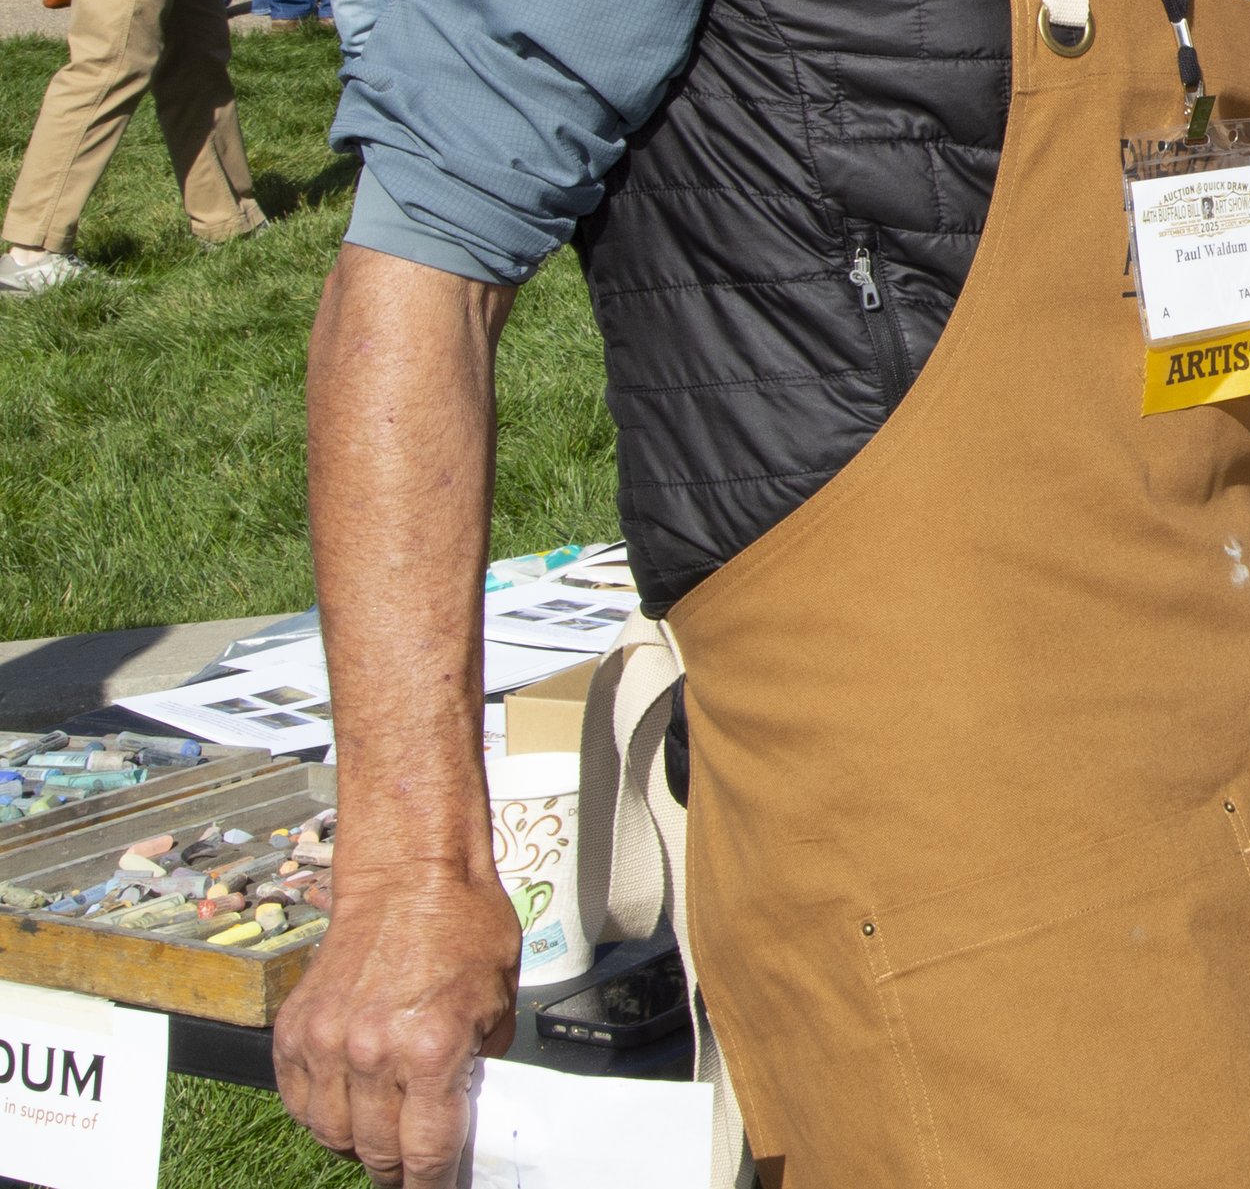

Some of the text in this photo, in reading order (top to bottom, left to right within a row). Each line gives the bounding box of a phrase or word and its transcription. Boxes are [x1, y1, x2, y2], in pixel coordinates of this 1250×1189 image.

[1163, 186, 1195, 203] AUCTION
[1203, 182, 1225, 193] QUICK
[1227, 181, 1249, 192] DRAW
[1142, 209, 1157, 224] 44TH
[1158, 205, 1186, 222] BUFFALO
[1187, 202, 1201, 219] BILL
[1215, 199, 1228, 213] ART
[1228, 195, 1247, 212] SHOW
[1200, 221, 1220, 233] 2025
[1176, 241, 1248, 262] Paul Waldum
[1162, 307, 1170, 319] A
[529, 938, 549, 954] 12
[4, 1097, 99, 1130] in support of
